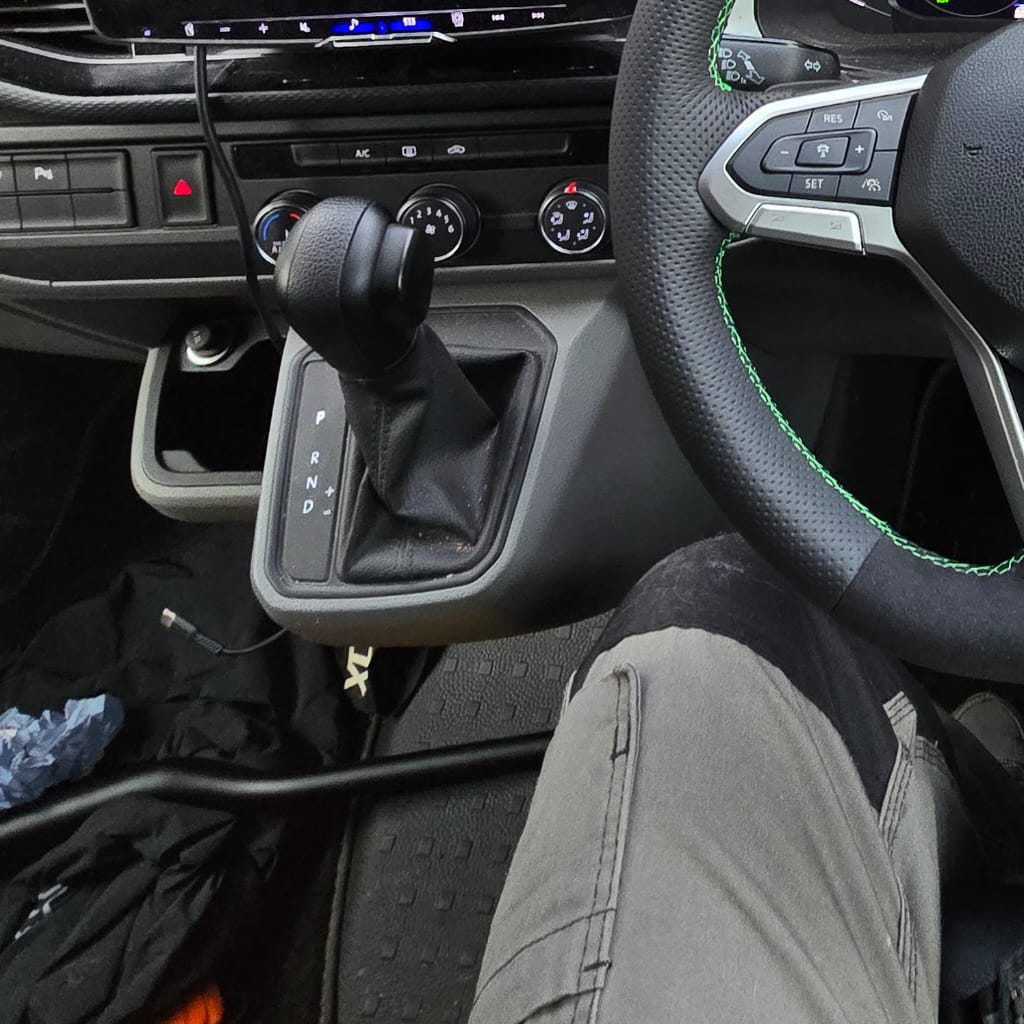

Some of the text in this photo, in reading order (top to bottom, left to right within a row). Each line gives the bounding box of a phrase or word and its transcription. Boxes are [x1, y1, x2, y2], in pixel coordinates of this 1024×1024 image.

[823, 113, 844, 124] RES
[355, 148, 371, 159] A/C
[805, 178, 825, 190] SET
[416, 209, 423, 219] 2
[447, 224, 455, 234] 6
[315, 410, 326, 425] P
[310, 451, 320, 465] R
[306, 475, 318, 490] N
[302, 499, 314, 514] D
